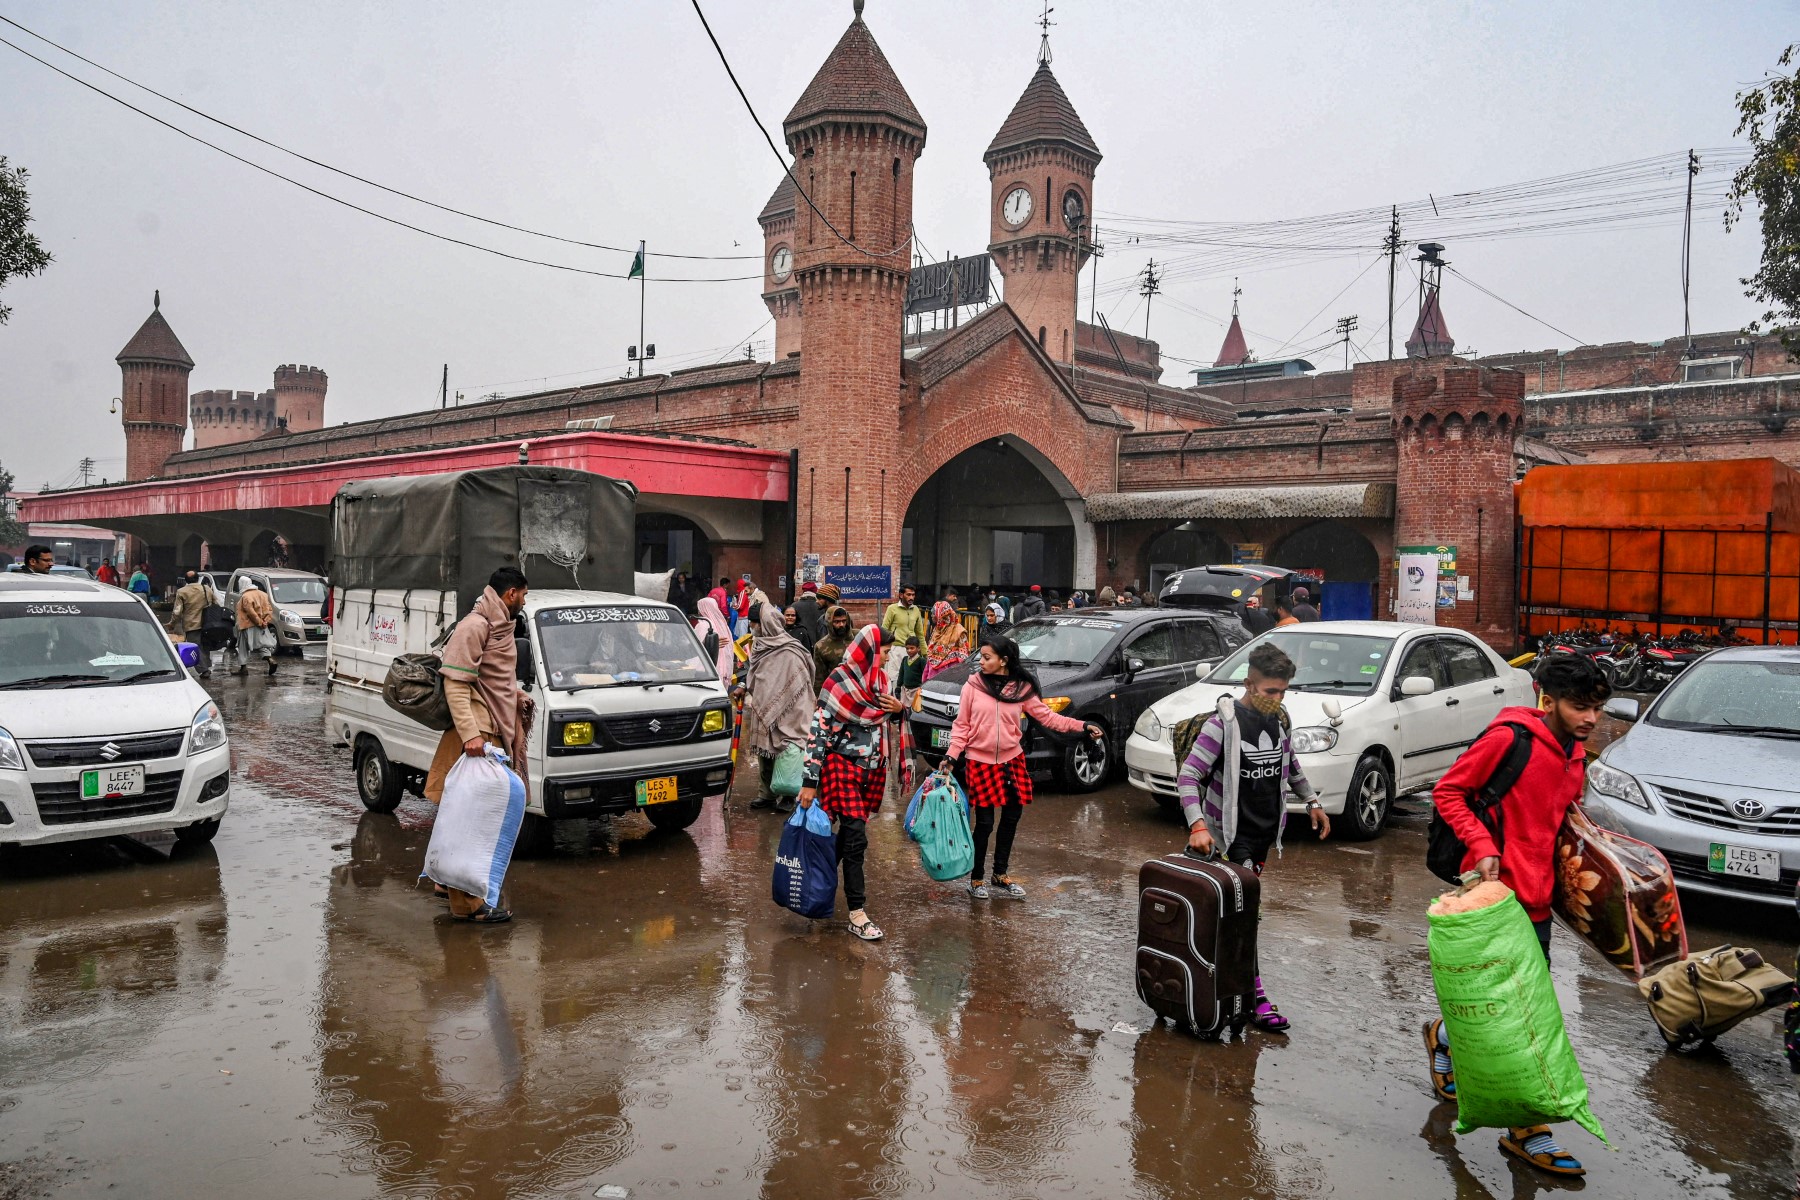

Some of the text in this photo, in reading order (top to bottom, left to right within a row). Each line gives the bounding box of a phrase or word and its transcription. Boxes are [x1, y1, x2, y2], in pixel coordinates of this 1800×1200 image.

[107, 781, 134, 792] 8447
[647, 791, 668, 802] 7492
[1727, 861, 1760, 875] 4741
